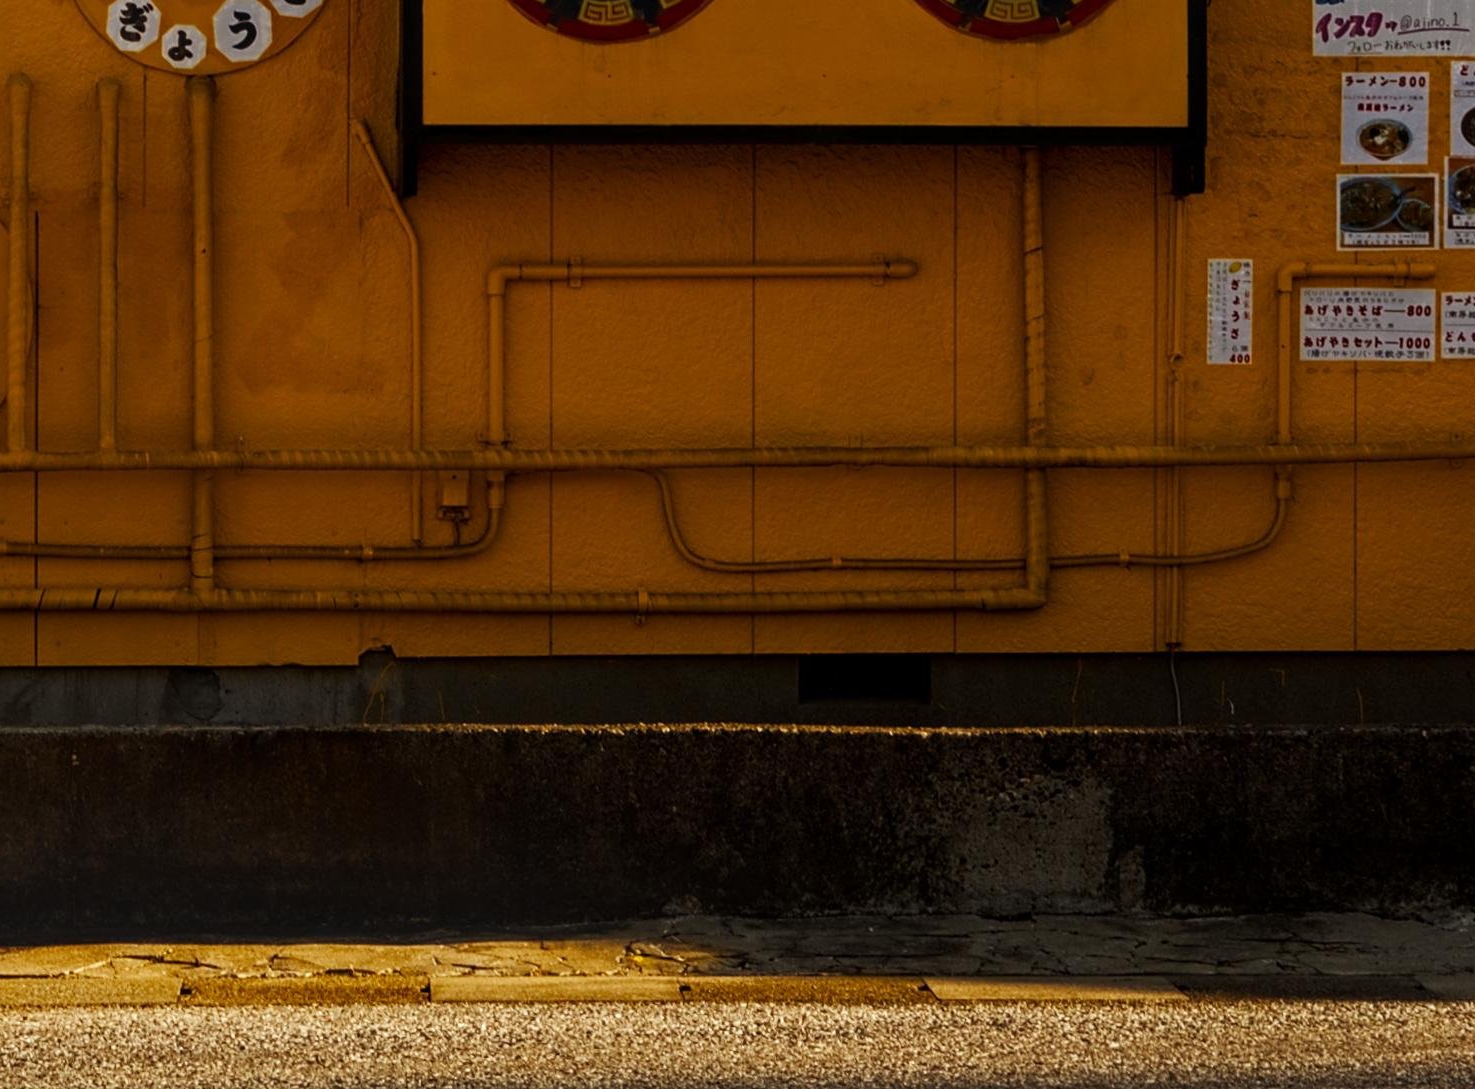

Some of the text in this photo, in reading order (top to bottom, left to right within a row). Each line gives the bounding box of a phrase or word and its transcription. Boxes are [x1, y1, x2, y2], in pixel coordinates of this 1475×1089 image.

[1398, 76, 1426, 88] 800
[1304, 303, 1432, 317] あげやきそば 800
[1399, 337, 1431, 350] 1000
[1229, 354, 1251, 364] 400
